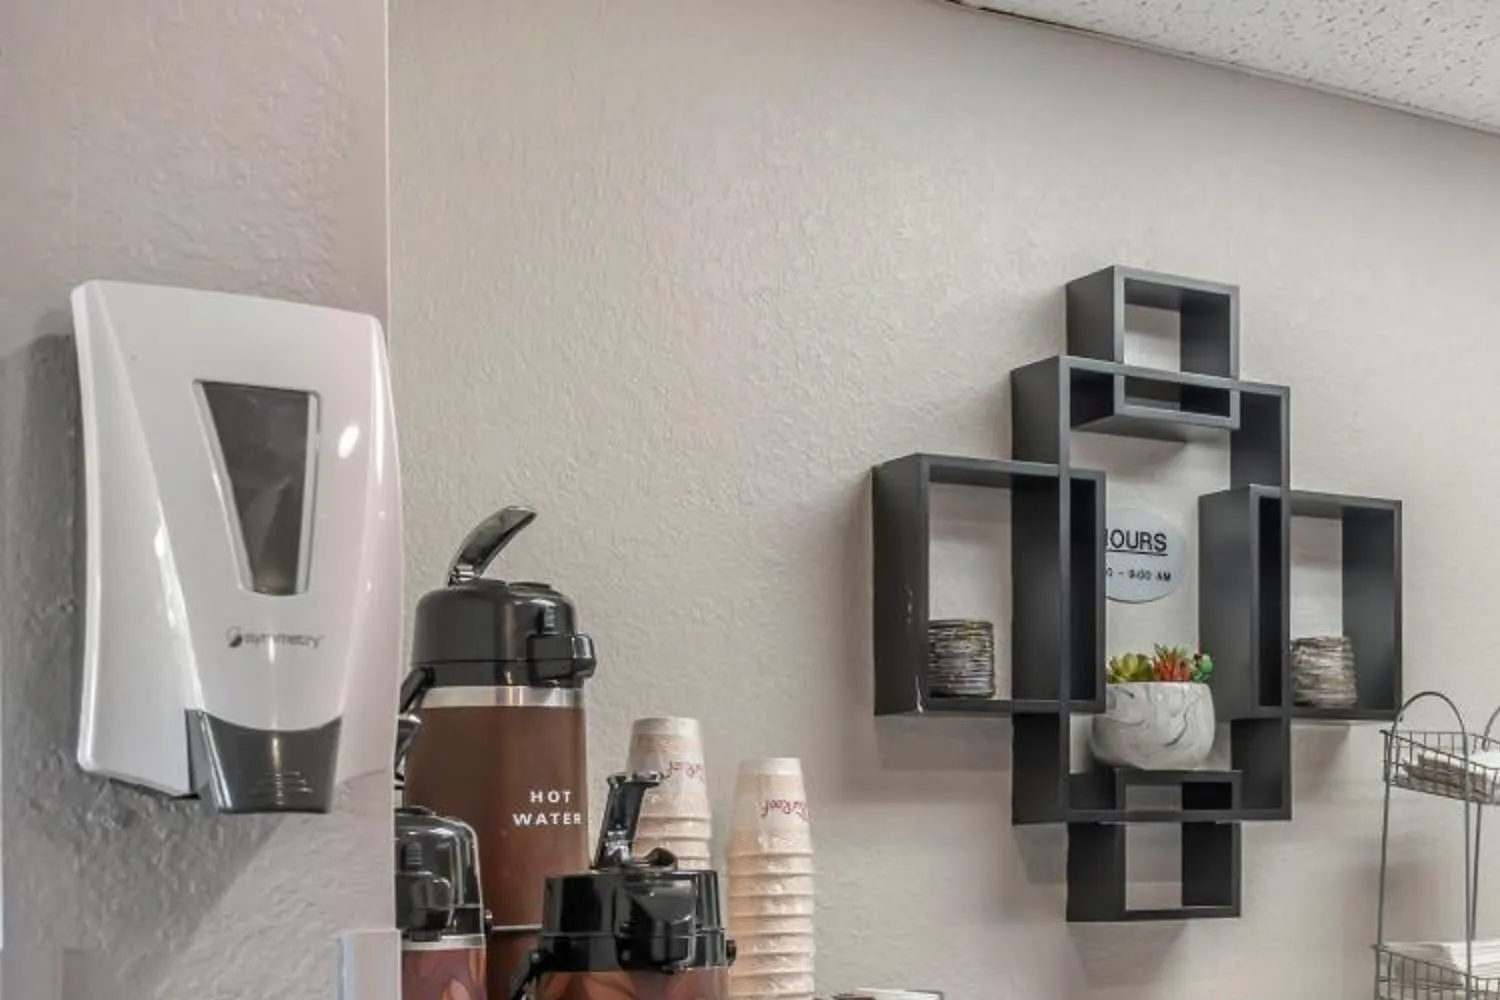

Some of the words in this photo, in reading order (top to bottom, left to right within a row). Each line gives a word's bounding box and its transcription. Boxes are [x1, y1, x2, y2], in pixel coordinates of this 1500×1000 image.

[1156, 571, 1172, 581] AM
[530, 789, 571, 803] HOT
[512, 811, 581, 827] WATER
